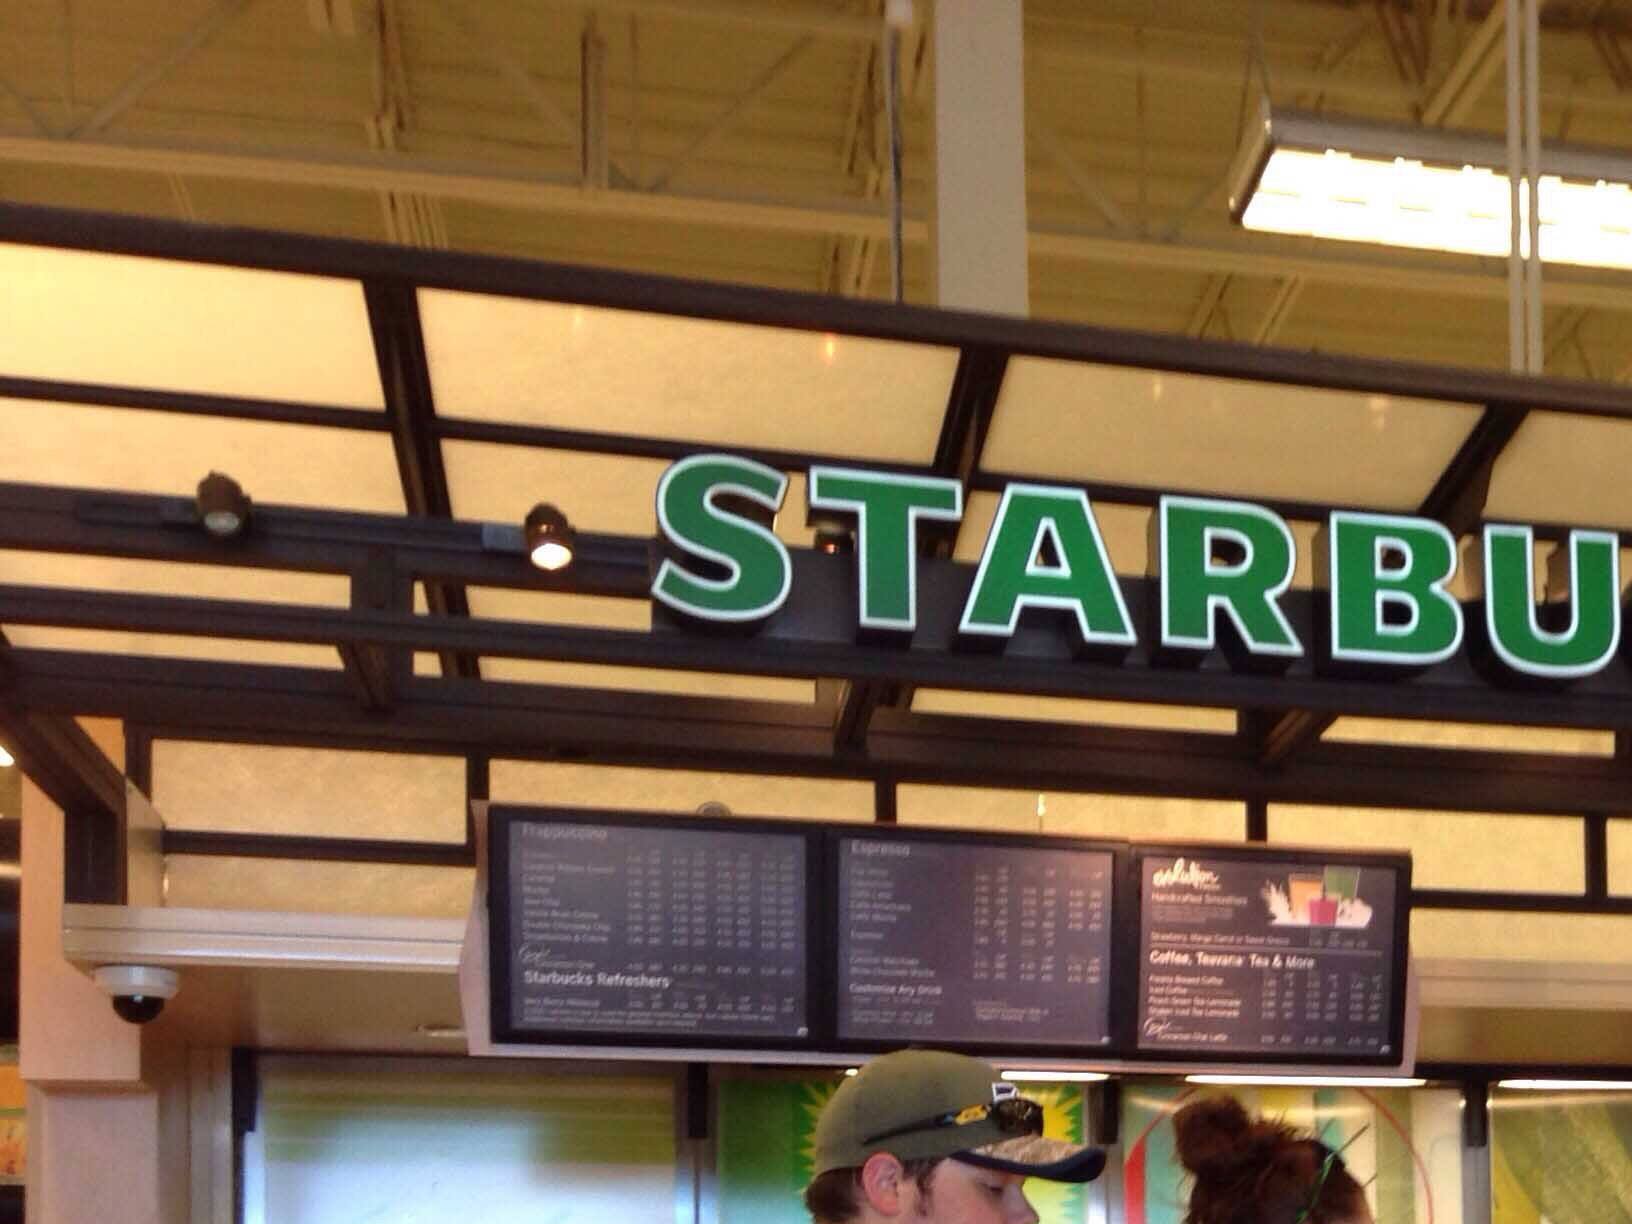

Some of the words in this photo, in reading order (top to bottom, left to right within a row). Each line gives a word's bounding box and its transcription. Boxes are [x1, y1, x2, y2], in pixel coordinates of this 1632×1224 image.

[851, 840, 911, 857] Espresso
[524, 970, 594, 987] Starbucks
[596, 972, 673, 990] Refreshers
